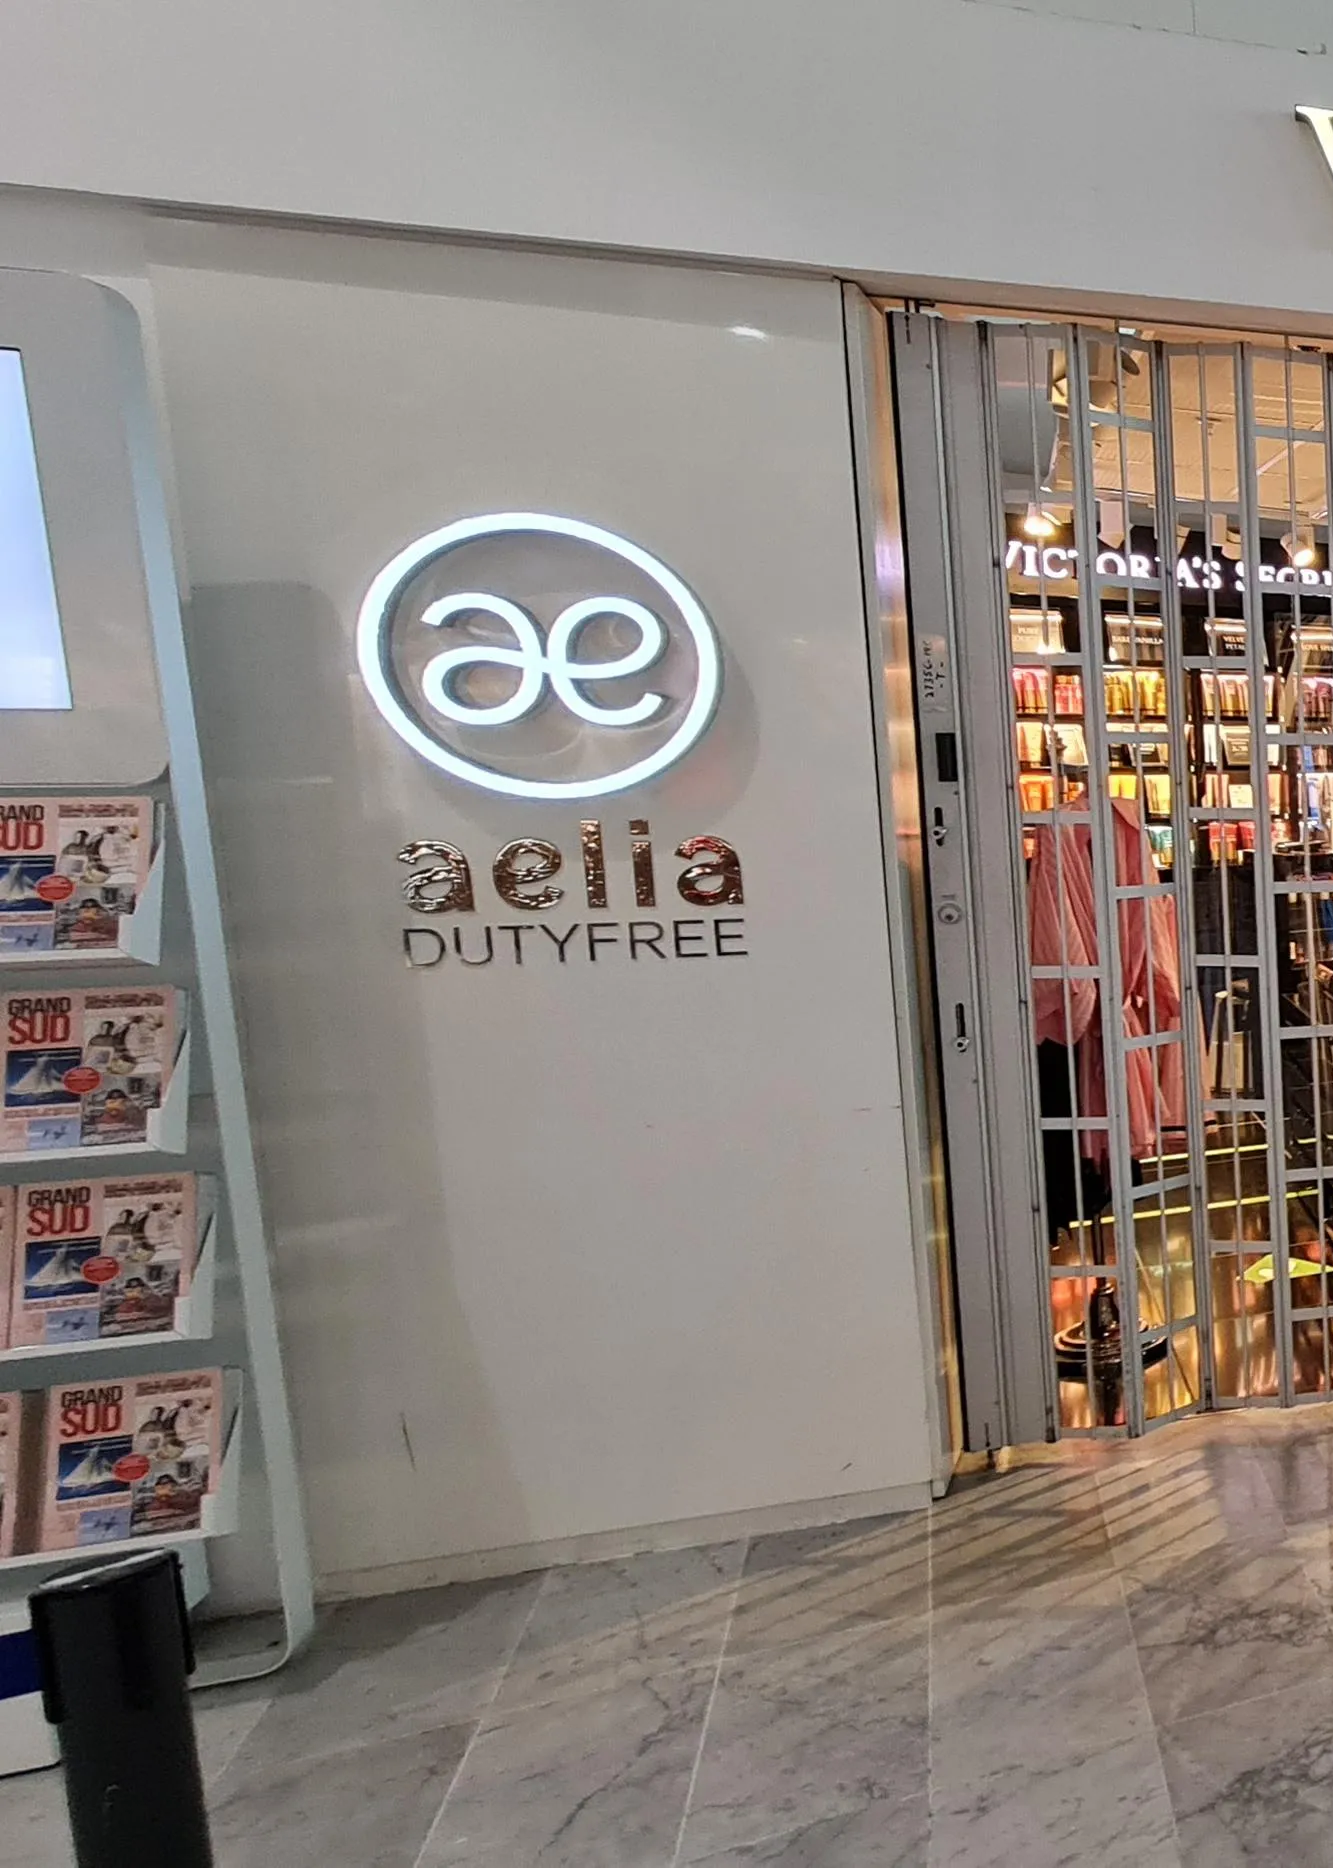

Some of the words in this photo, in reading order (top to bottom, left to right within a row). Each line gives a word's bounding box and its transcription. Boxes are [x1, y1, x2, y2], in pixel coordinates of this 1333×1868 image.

[0, 821, 44, 850] UD
[397, 816, 745, 914] aelia
[402, 917, 749, 970] DUTYFREE
[8, 996, 72, 1017] GRAND
[8, 1014, 71, 1045] SUD
[27, 1186, 91, 1207] GRAND
[27, 1204, 90, 1236] SUD
[61, 1385, 123, 1409] GRAND
[61, 1403, 122, 1437] SUD
